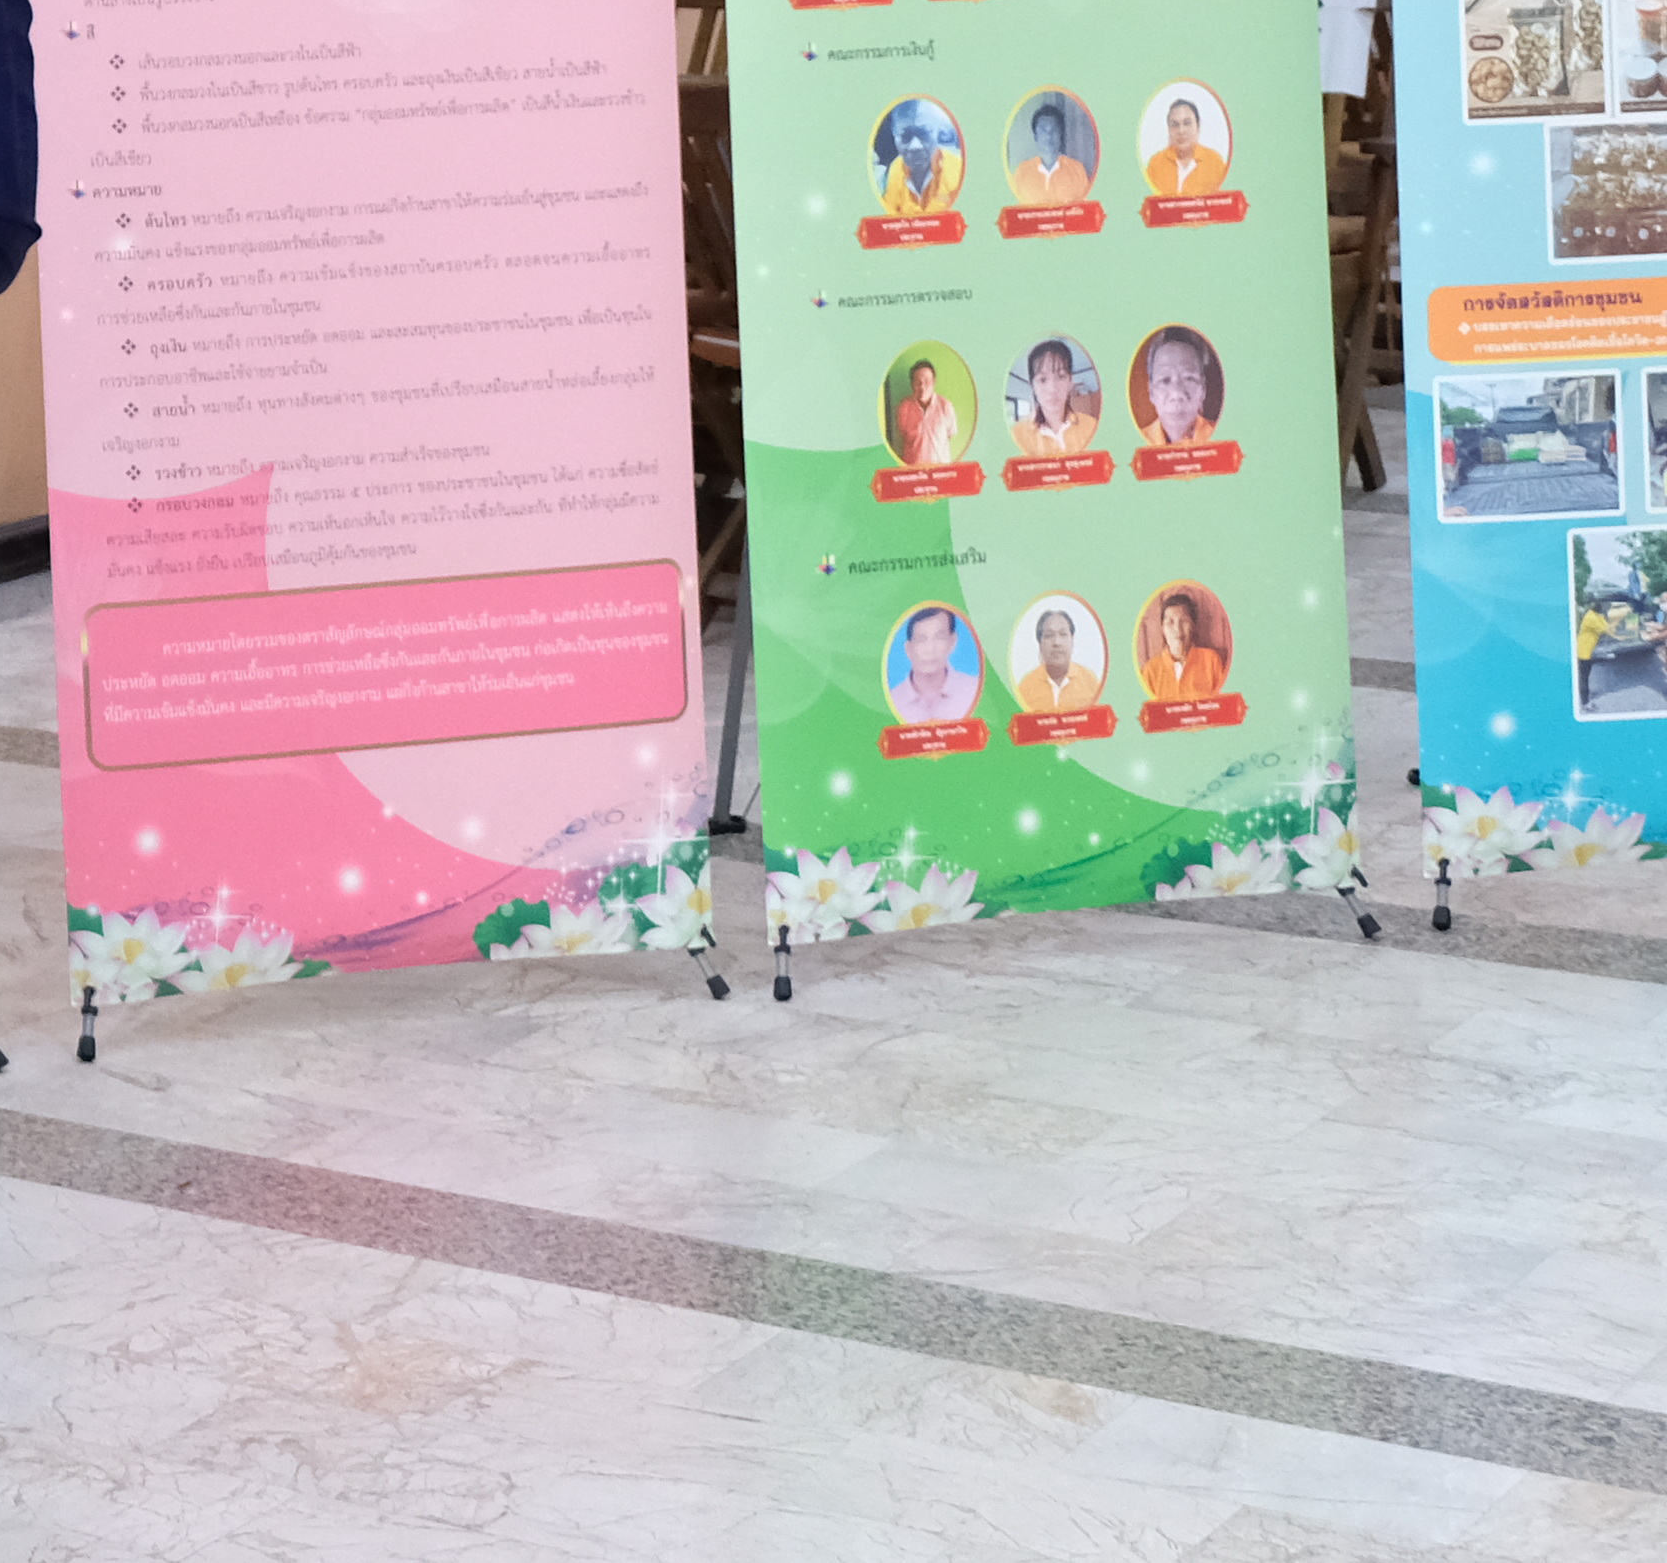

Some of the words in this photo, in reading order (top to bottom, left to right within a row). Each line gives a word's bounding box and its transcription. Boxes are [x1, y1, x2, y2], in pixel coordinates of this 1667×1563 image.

[848, 548, 987, 576] คณะกรรมการส่งเสริม
